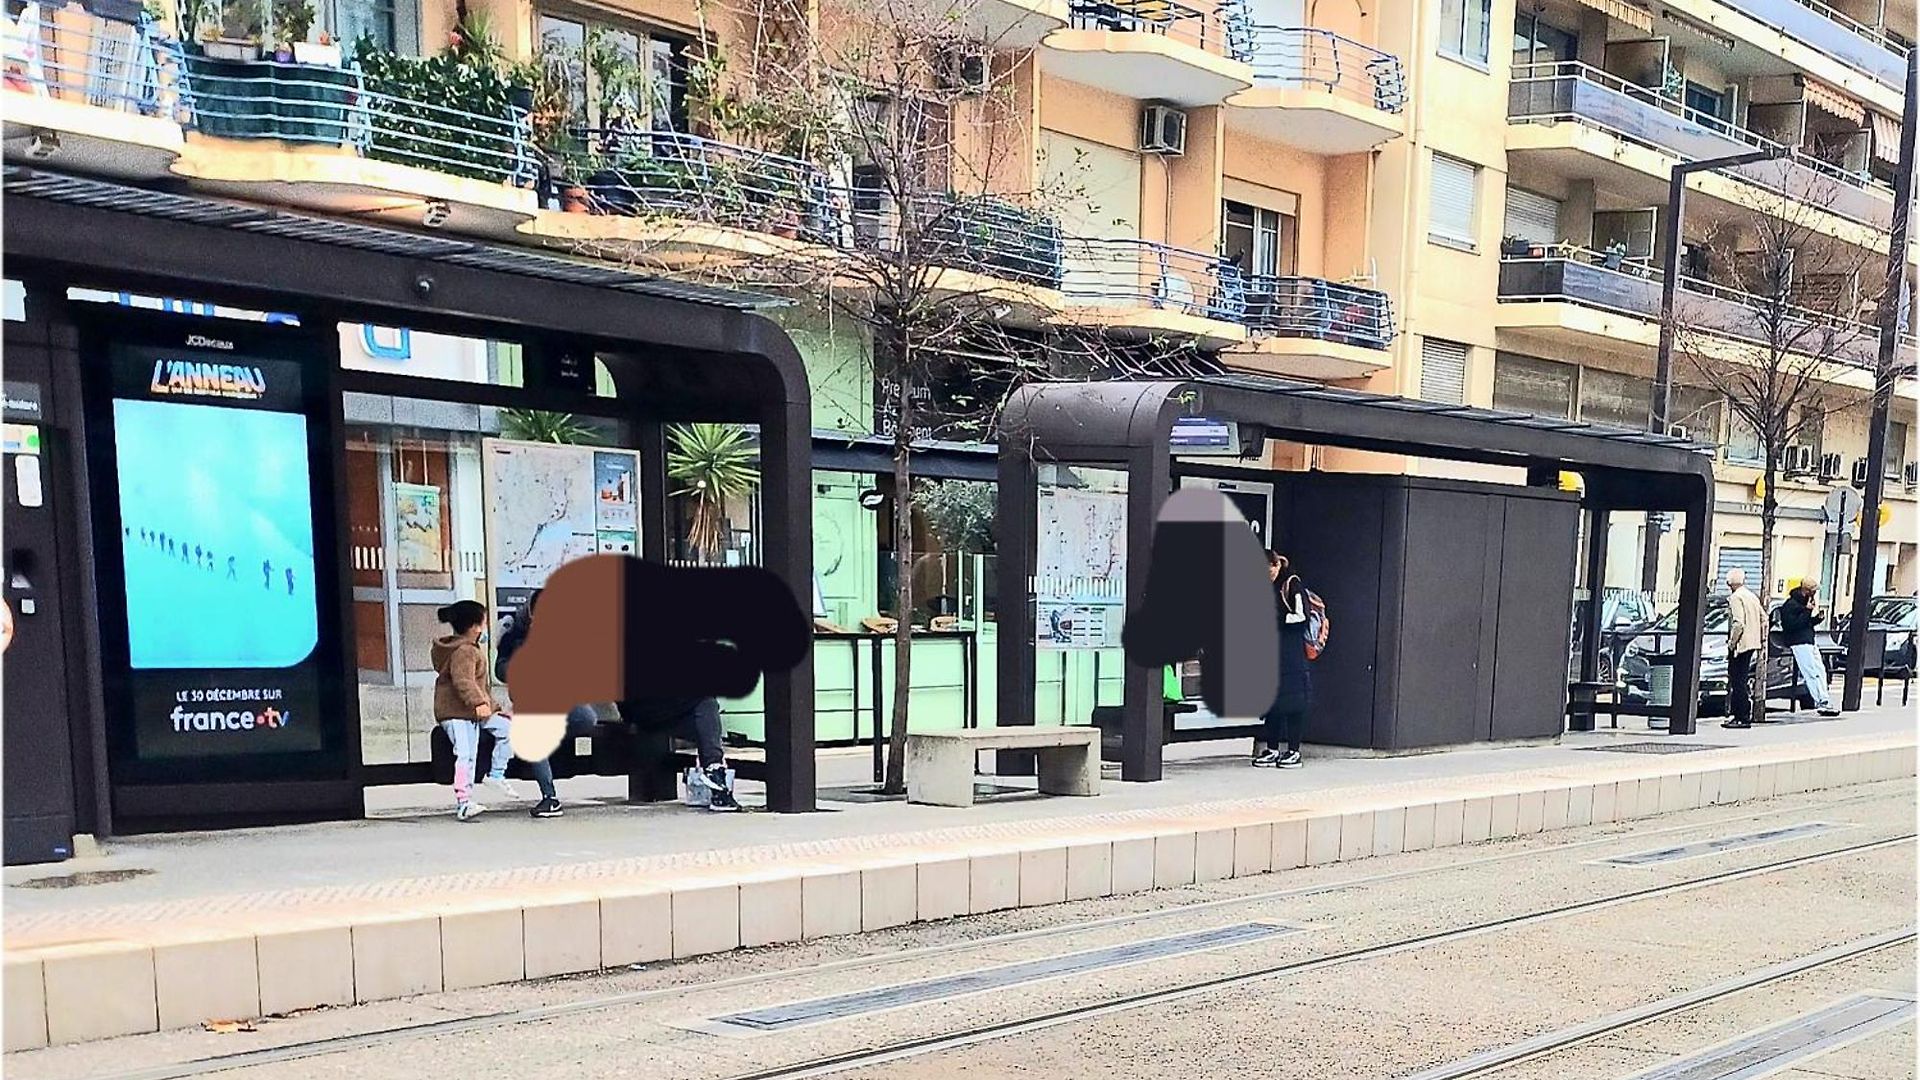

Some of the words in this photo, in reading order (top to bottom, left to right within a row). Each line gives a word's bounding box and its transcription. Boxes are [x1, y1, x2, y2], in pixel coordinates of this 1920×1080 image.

[150, 359, 266, 394] L'ANNEAU
[881, 378, 931, 400] Preum
[176, 690, 188, 702] LE
[191, 689, 204, 702] 30
[263, 688, 282, 700] SUR
